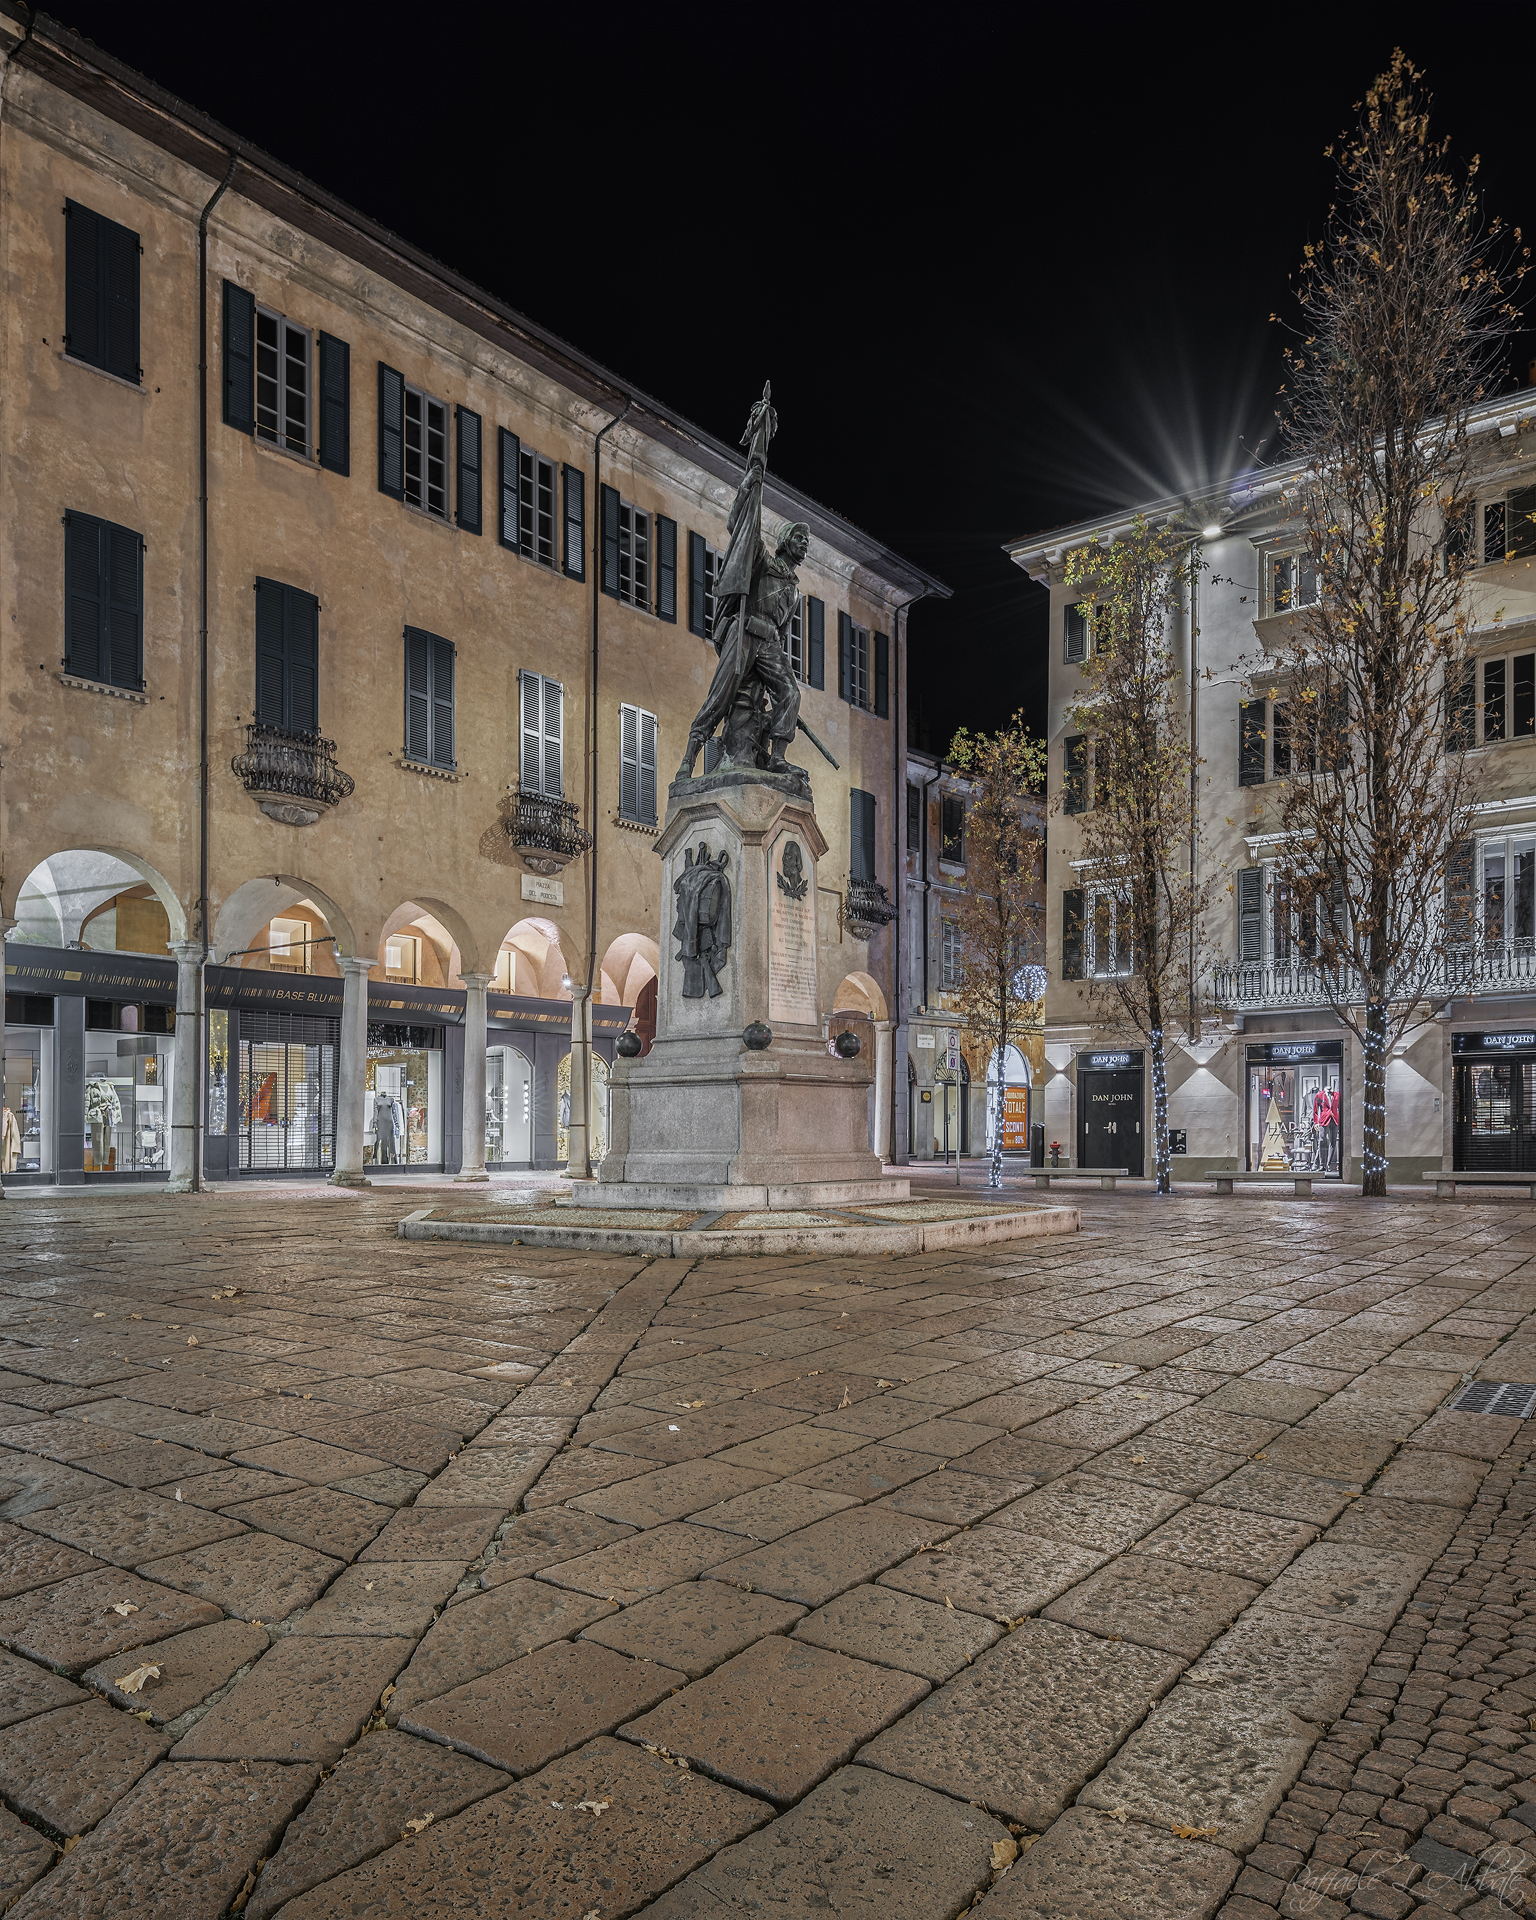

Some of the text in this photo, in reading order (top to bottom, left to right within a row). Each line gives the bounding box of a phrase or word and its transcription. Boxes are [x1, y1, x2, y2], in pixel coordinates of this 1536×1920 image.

[535, 881, 551, 890] PIAZZA
[528, 889, 537, 897] DEL
[276, 989, 328, 1003] BASE BLU
[1483, 1034, 1535, 1046] DAN JOHN
[1272, 1045, 1316, 1056] DAN JOHN
[1092, 1055, 1129, 1064] DAN JOHN
[1092, 1094, 1134, 1103] DAN JOHN
[1005, 1101, 1026, 1114] TOTALE
[1005, 1121, 1025, 1133] SCONTI
